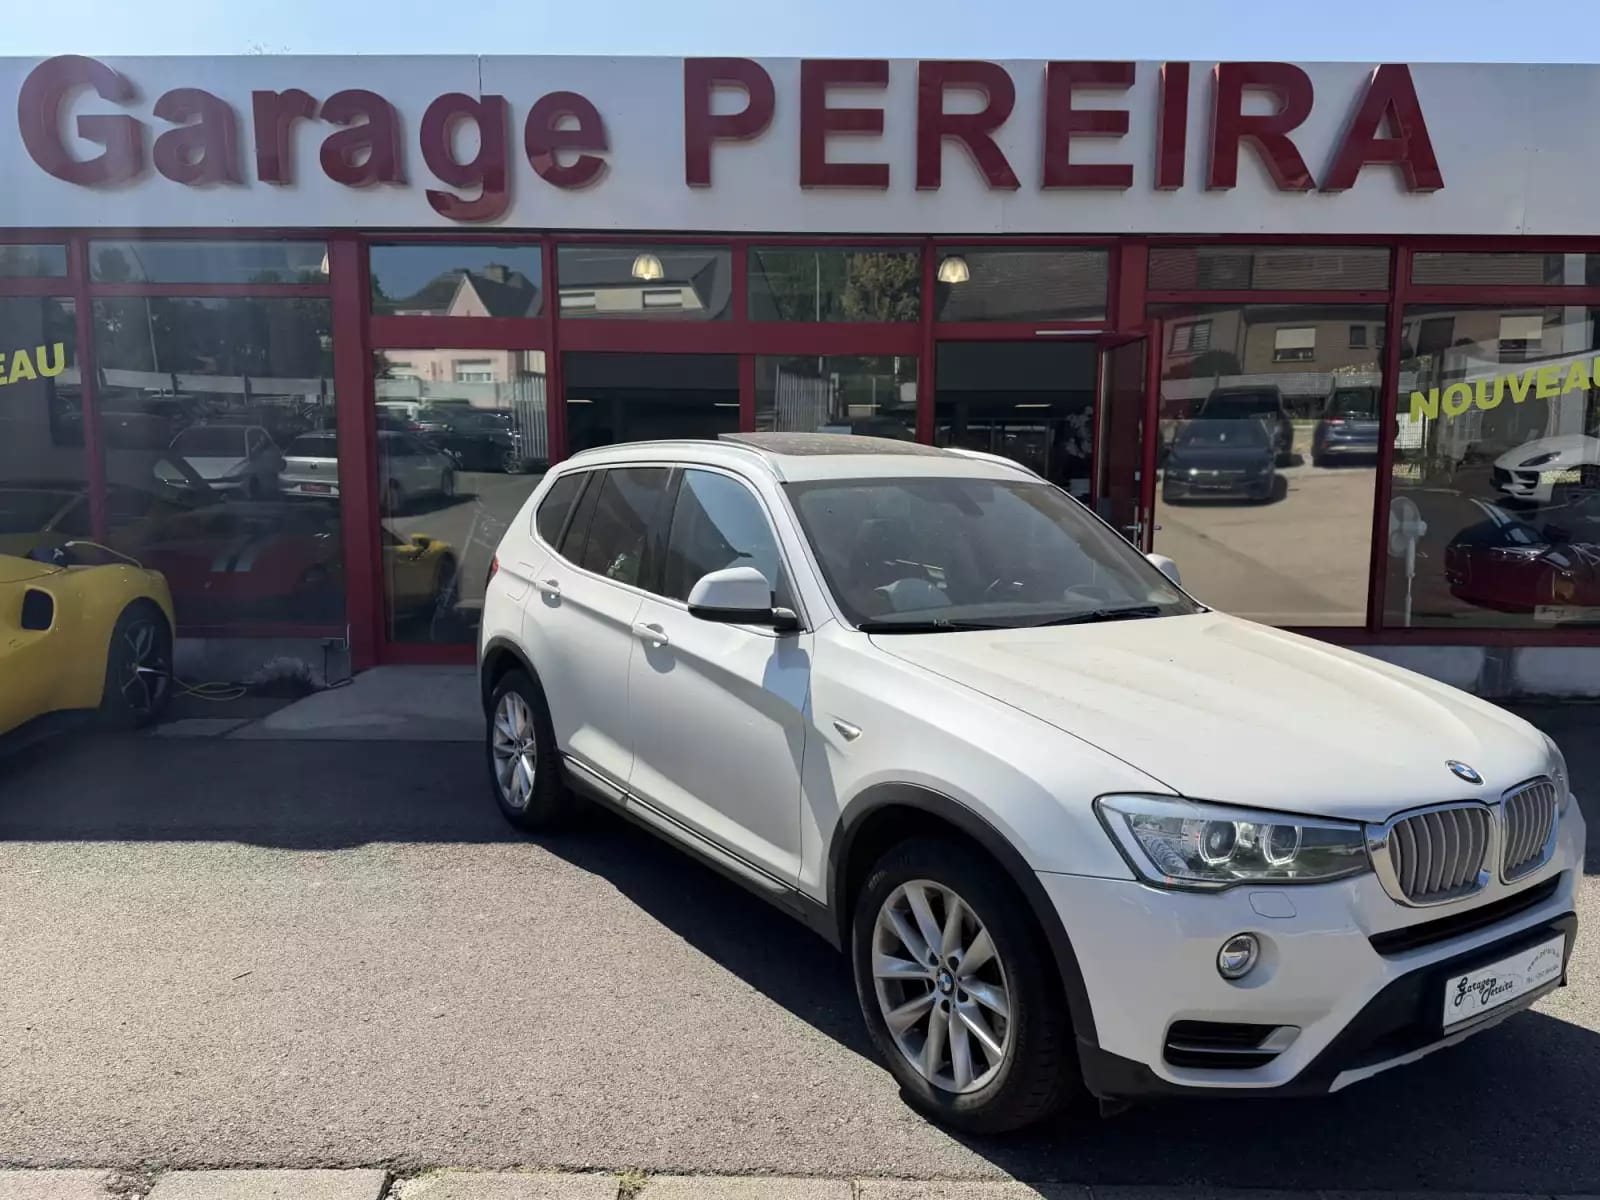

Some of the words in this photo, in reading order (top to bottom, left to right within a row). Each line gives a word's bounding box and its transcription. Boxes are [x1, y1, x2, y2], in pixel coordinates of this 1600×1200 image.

[18, 54, 609, 223] Garage
[684, 57, 1445, 192] PEREIRA
[1408, 355, 1600, 423] NOUVEA
